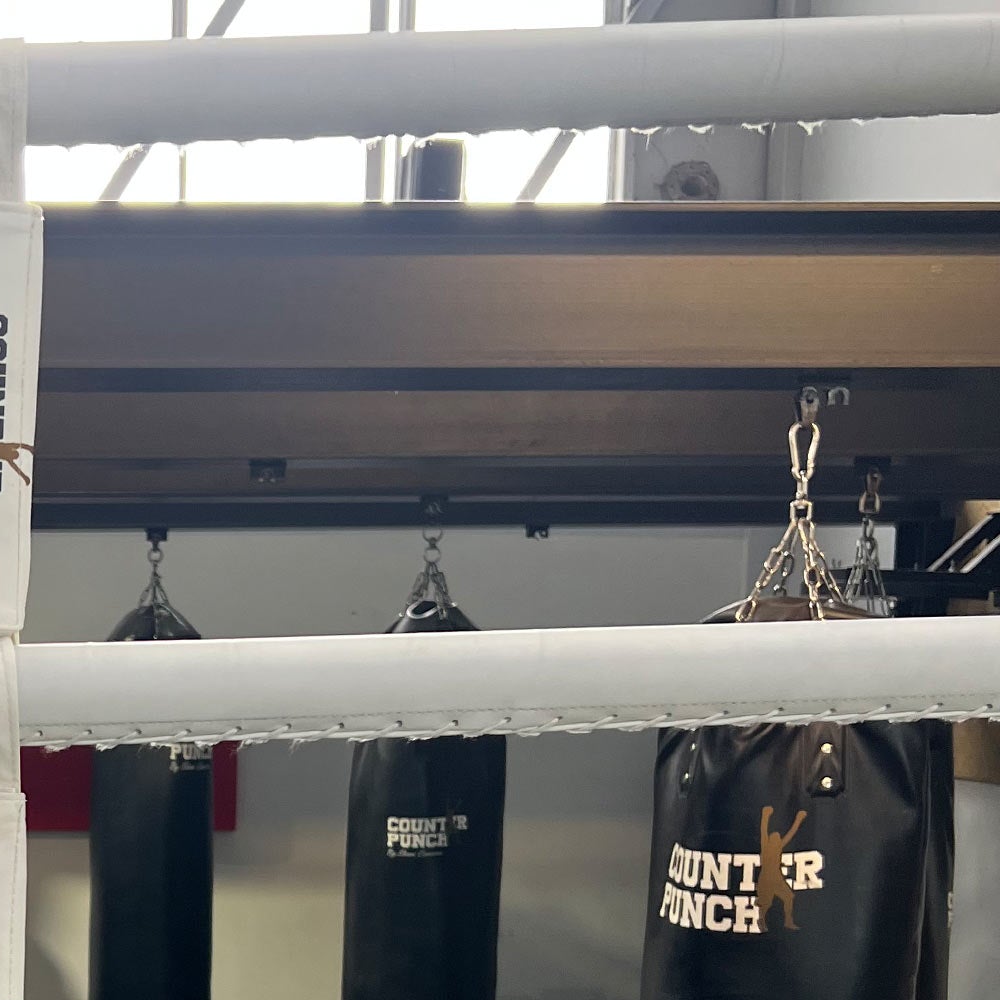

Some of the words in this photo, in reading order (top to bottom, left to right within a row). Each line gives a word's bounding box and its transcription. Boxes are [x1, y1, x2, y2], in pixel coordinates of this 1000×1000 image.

[387, 815, 467, 833] COUNTR
[386, 833, 448, 848] PUNCH
[659, 882, 762, 934] PUNCH
